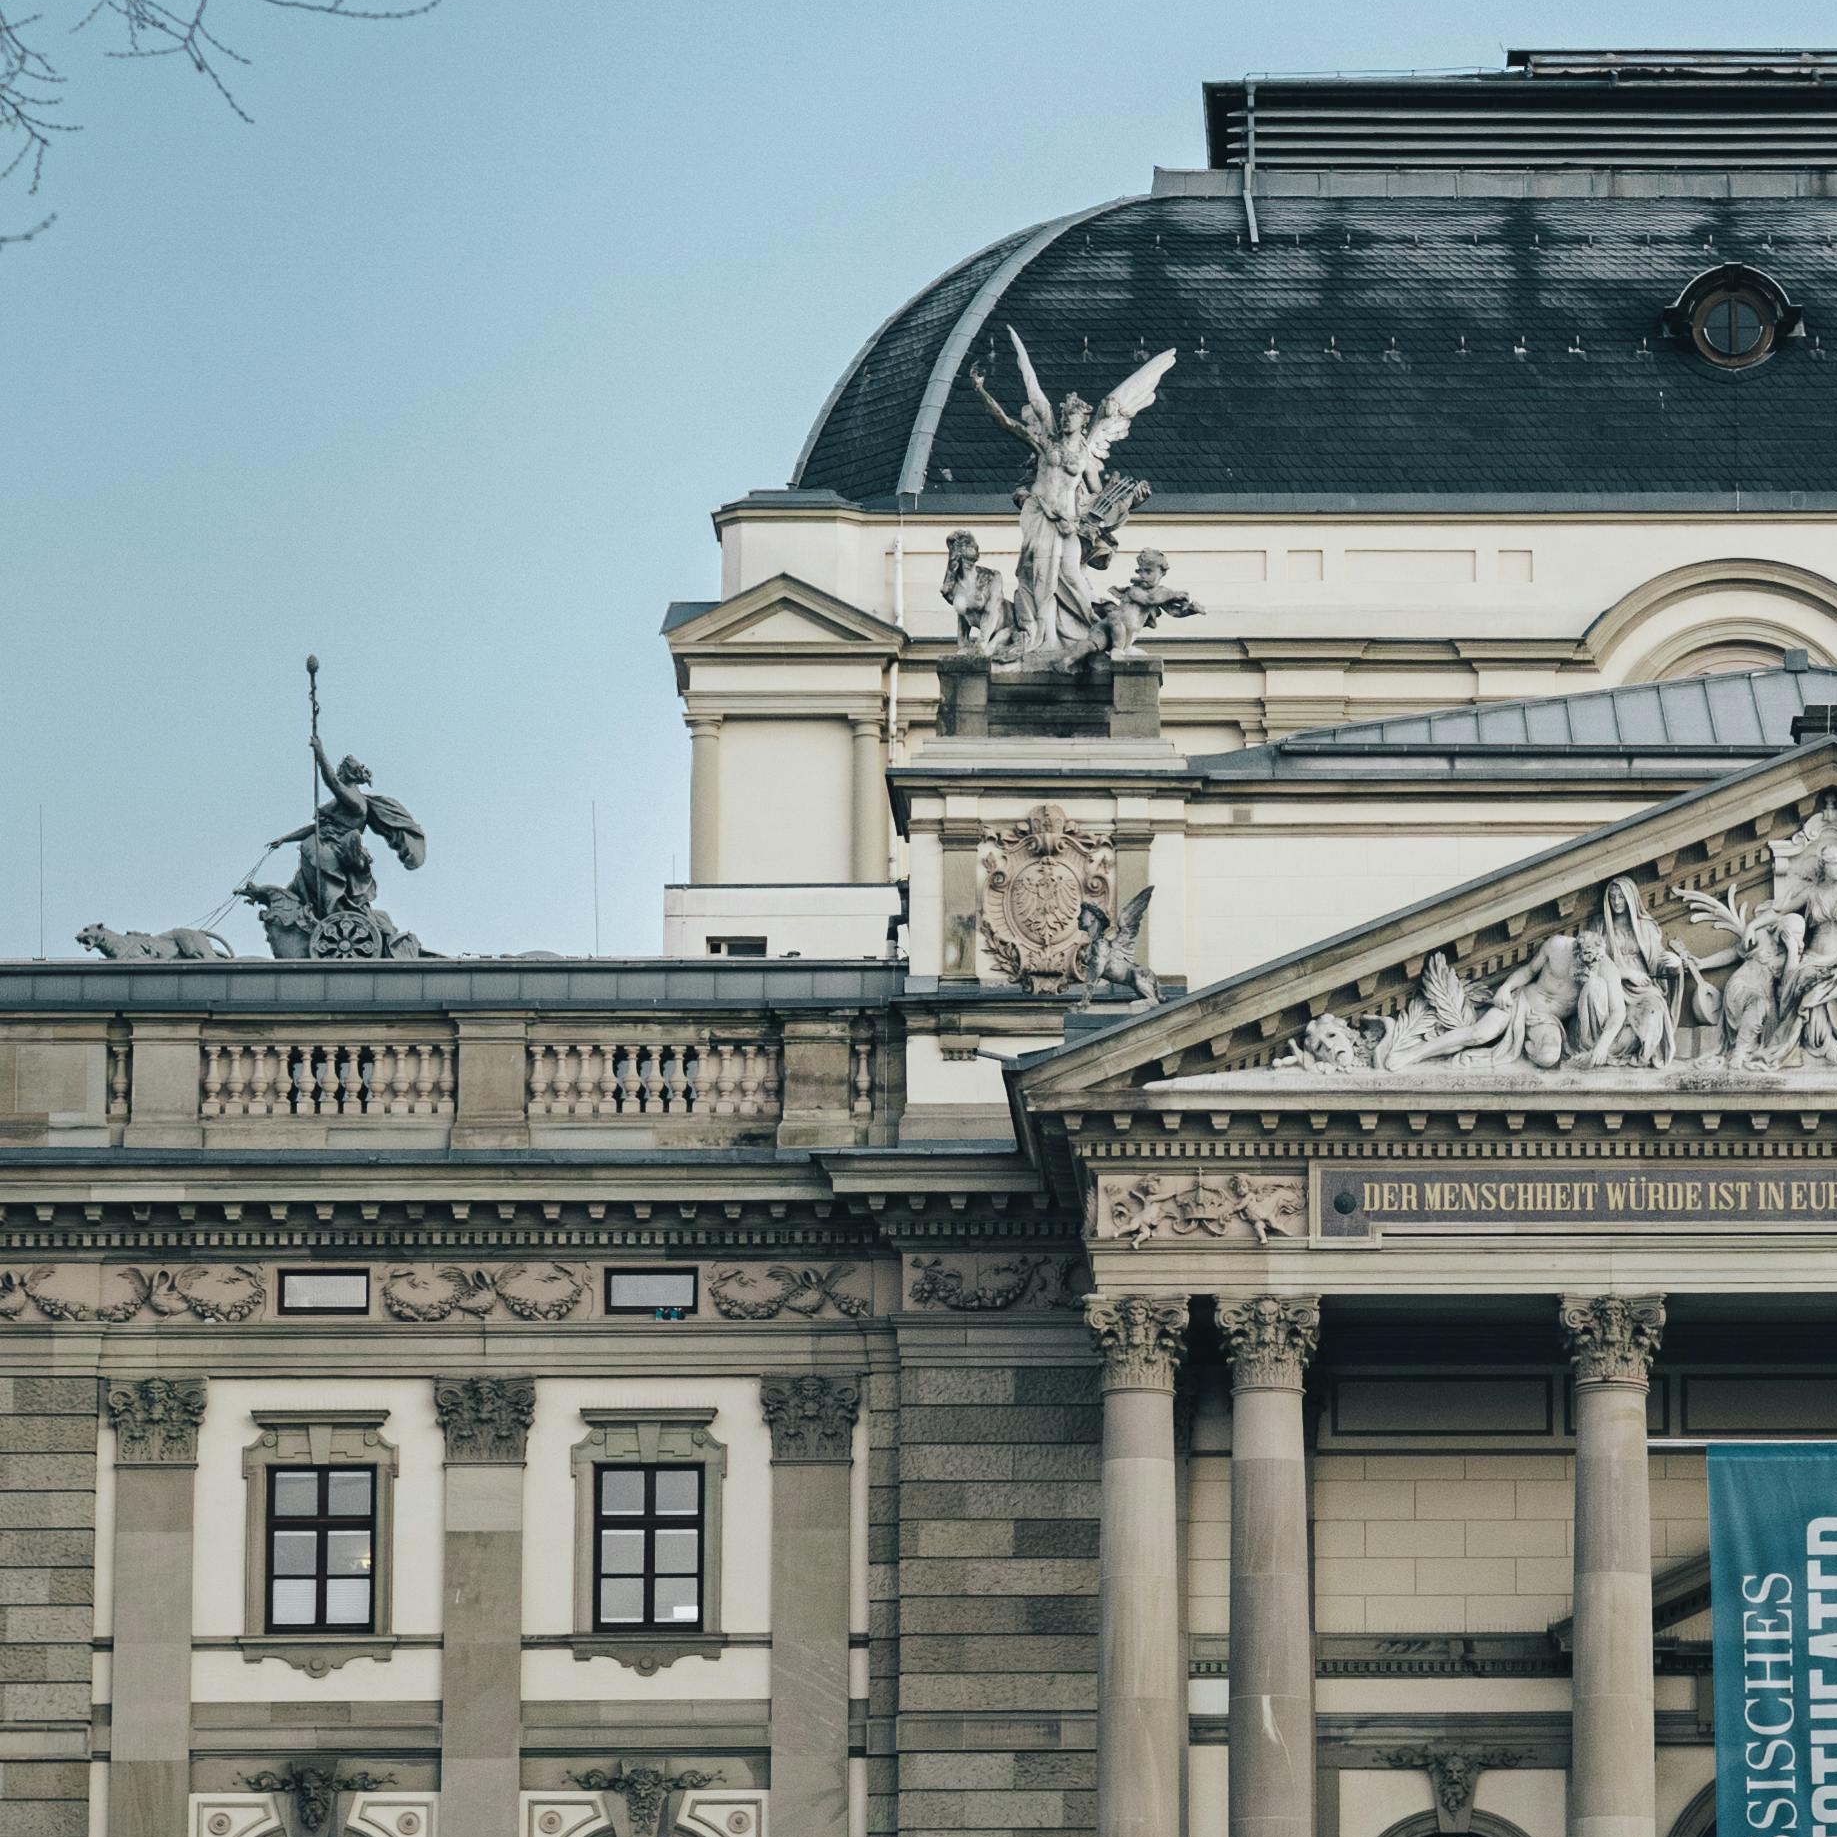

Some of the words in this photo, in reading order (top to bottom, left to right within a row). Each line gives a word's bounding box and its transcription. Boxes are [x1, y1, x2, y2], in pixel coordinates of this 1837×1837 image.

[1362, 1182, 1418, 1212] DER
[1424, 1182, 1598, 1212] MENSCHHEIT
[1605, 1176, 1702, 1211] WÜRDE
[1707, 1181, 1751, 1211] IST
[1757, 1181, 1785, 1211] IN
